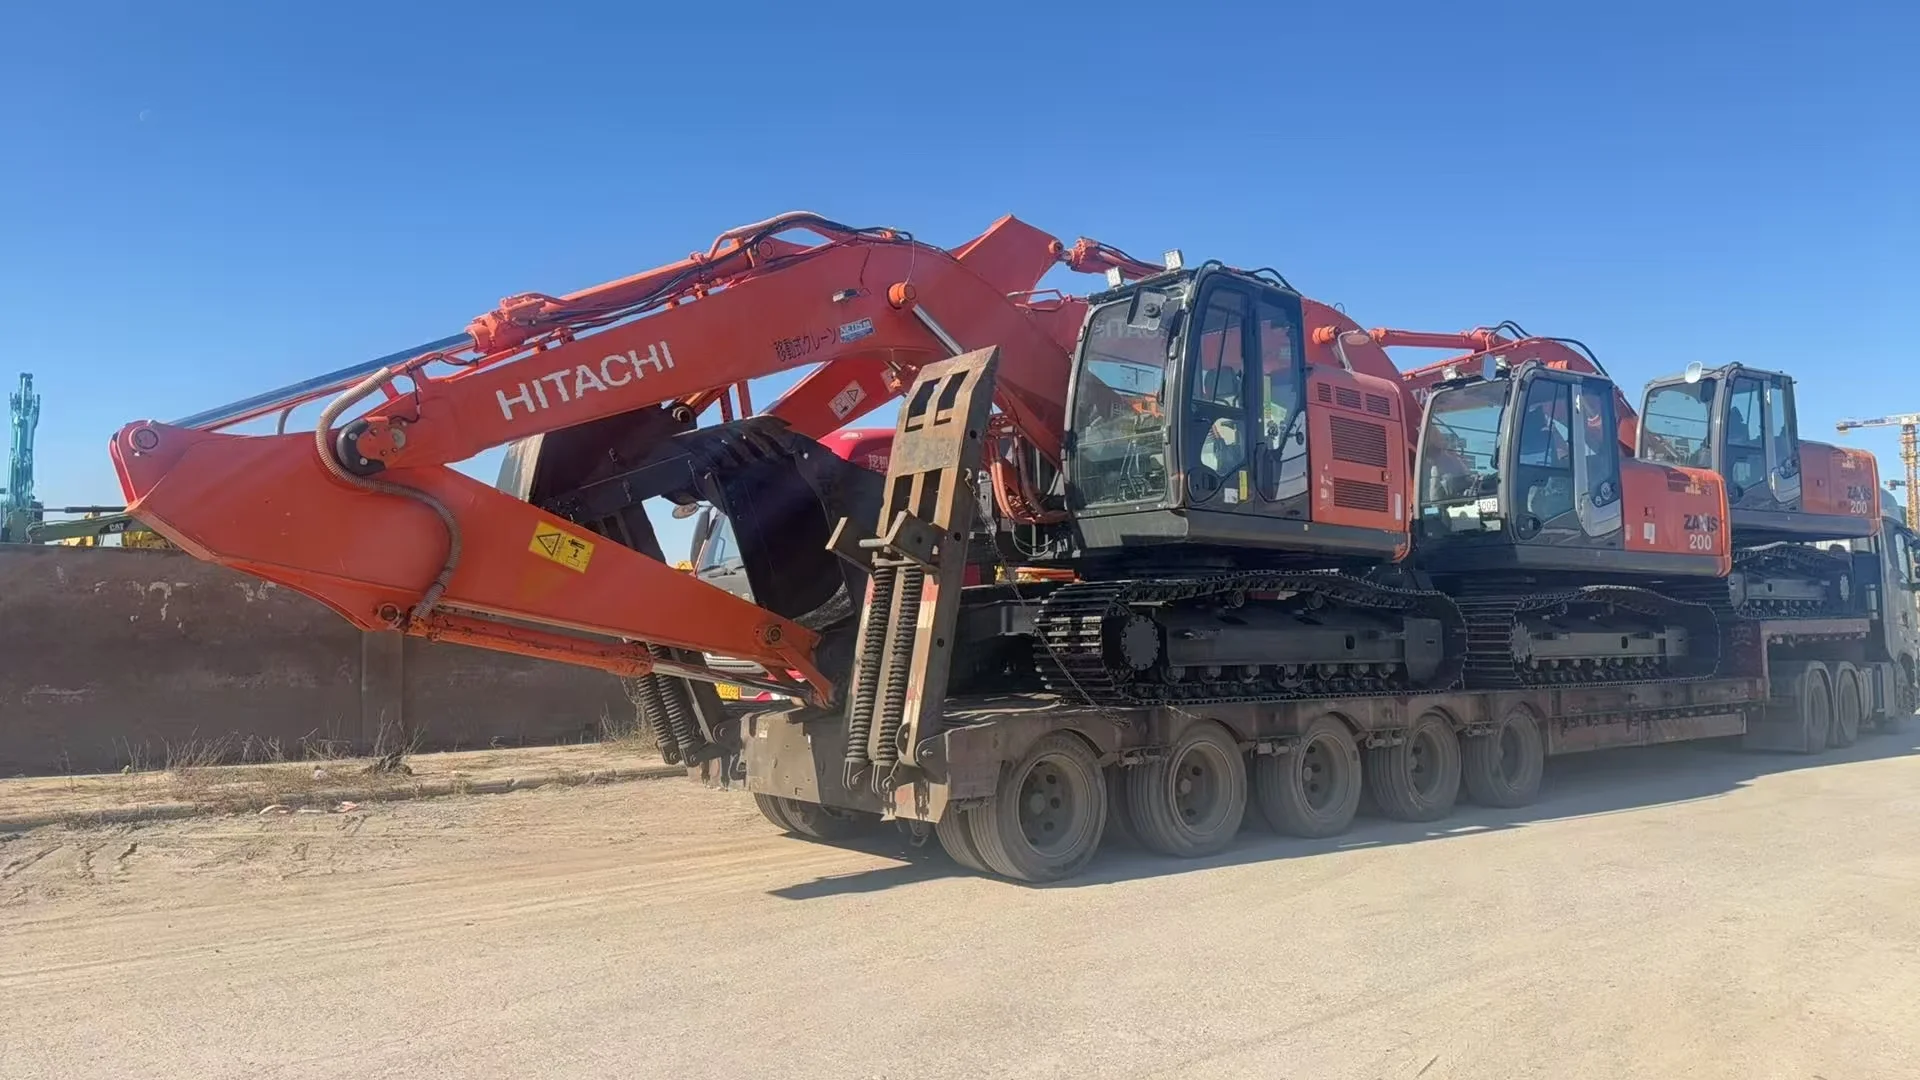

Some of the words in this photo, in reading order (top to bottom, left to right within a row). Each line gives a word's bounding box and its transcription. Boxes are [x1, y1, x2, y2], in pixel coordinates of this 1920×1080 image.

[773, 327, 837, 362] 移動式クレーン
[495, 340, 674, 421] HITACHI
[1850, 500, 1868, 514] 200
[109, 522, 125, 532] CAT
[1690, 534, 1712, 551] 200
